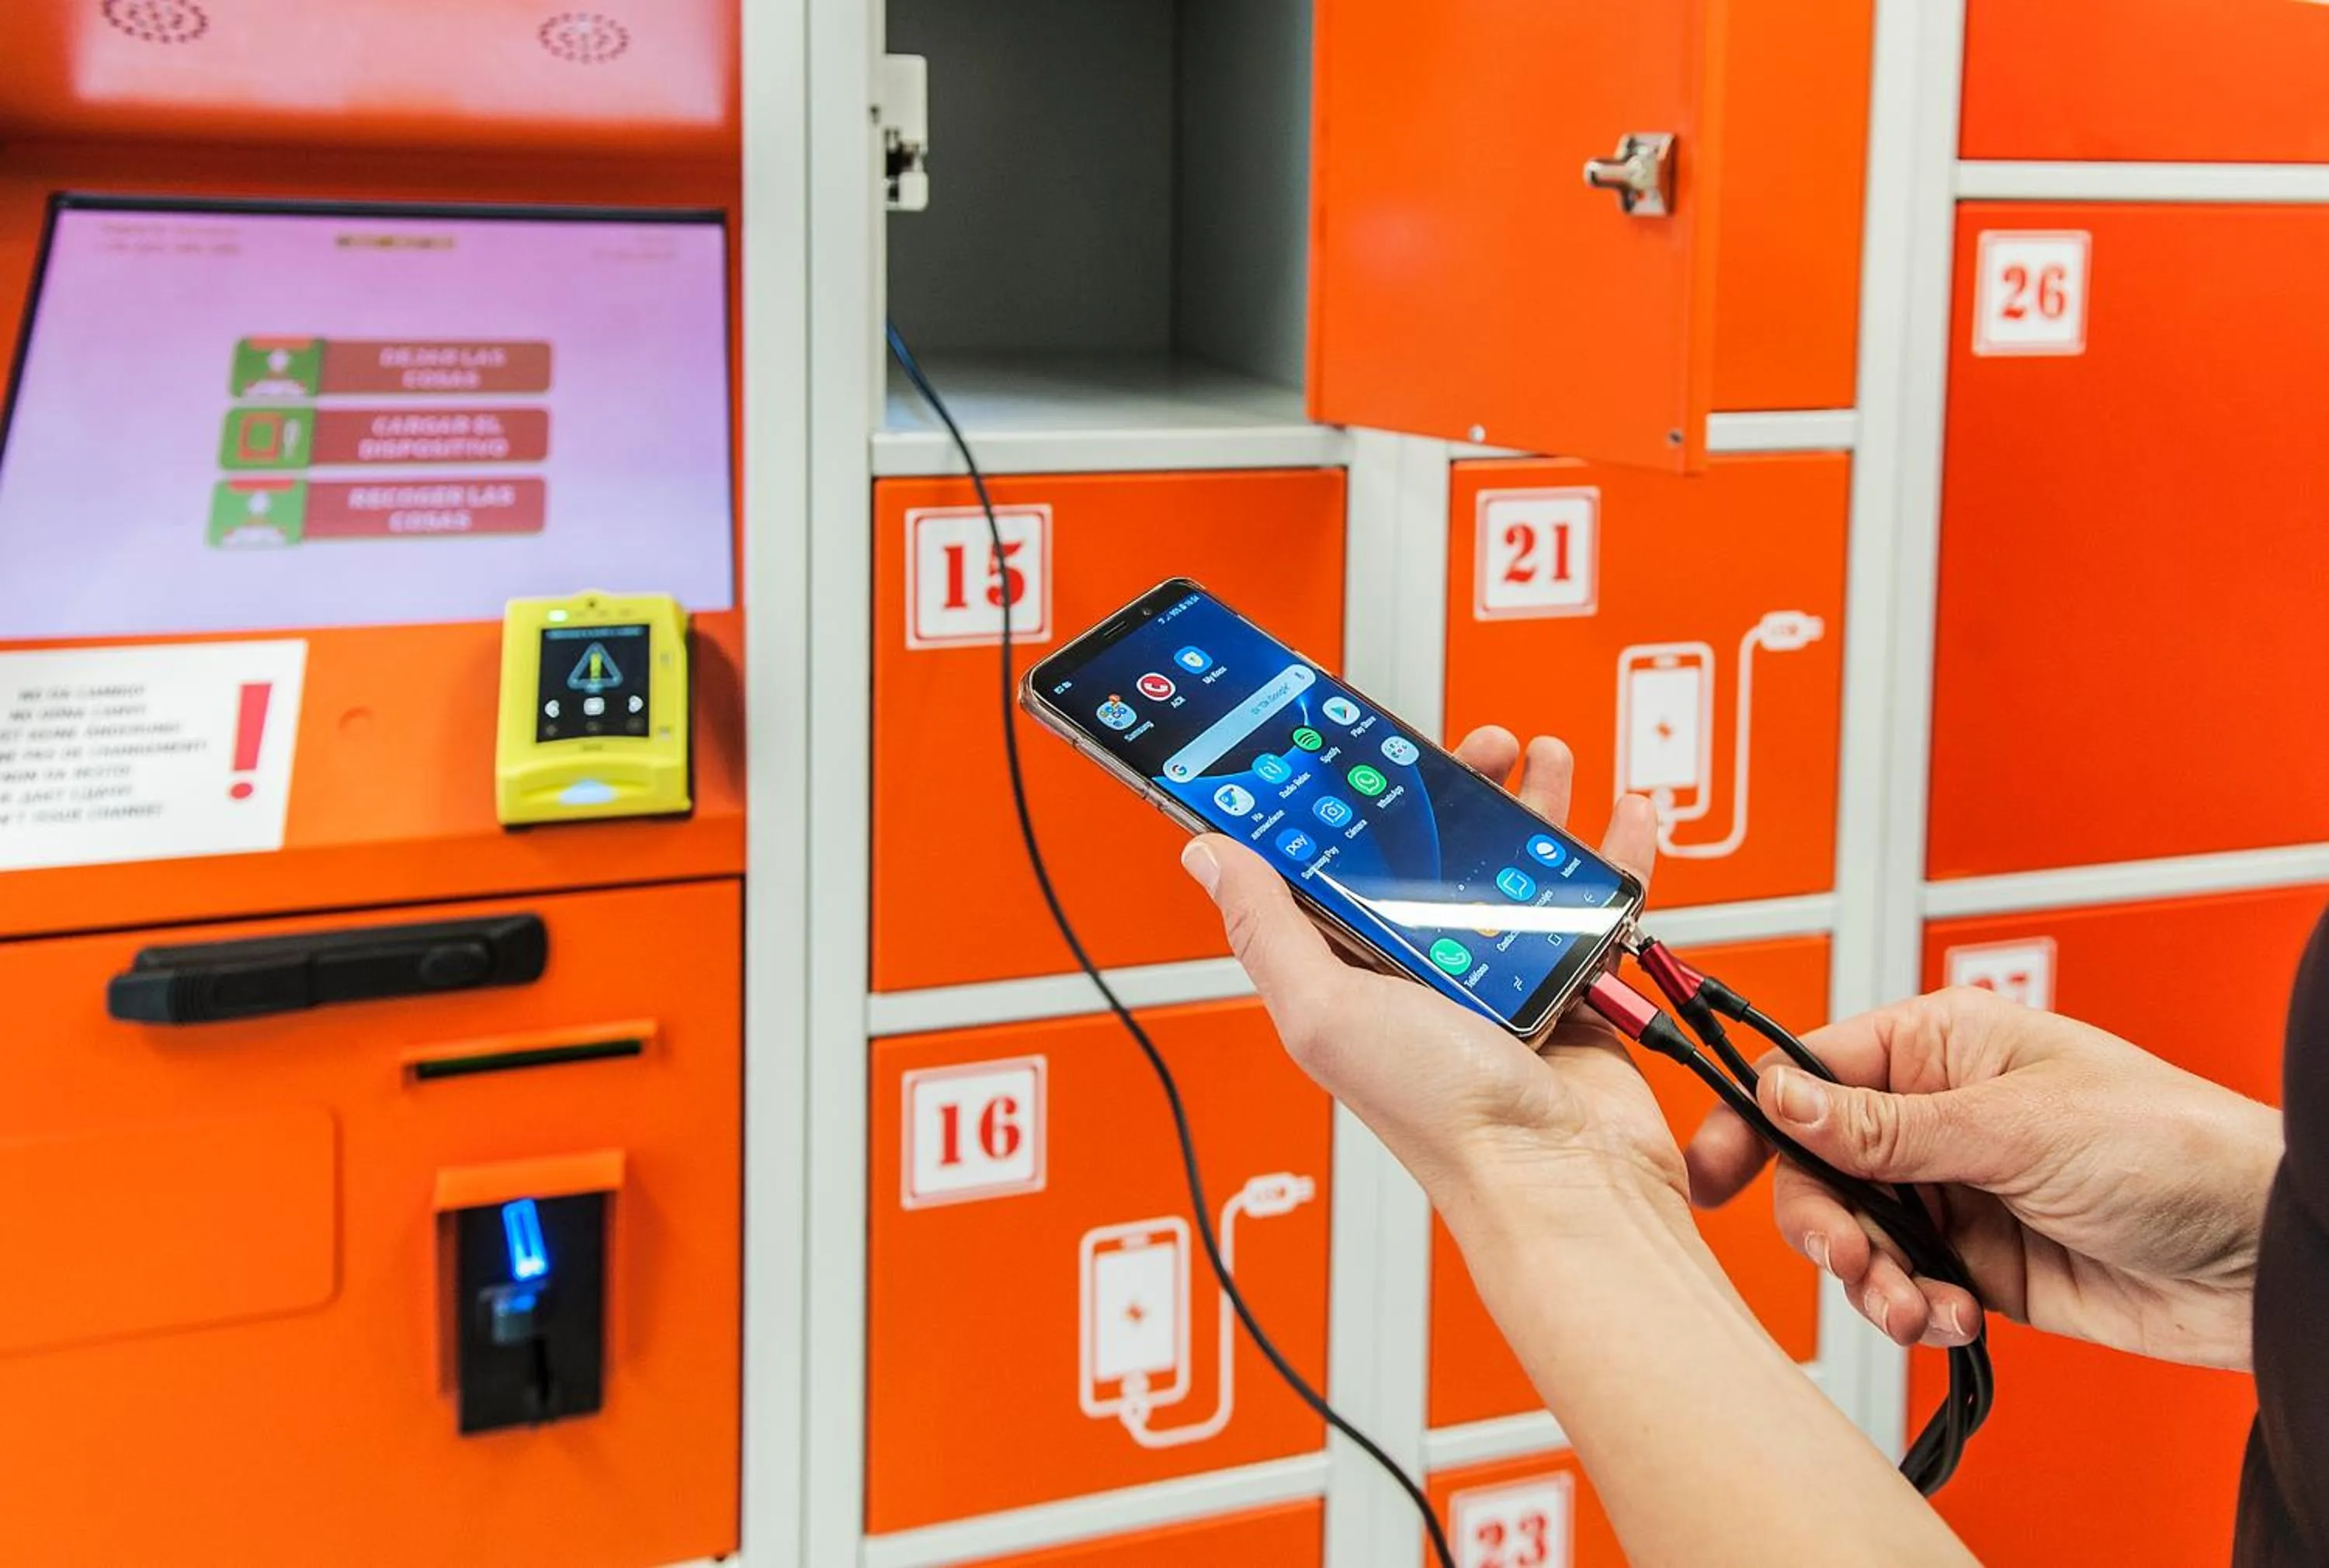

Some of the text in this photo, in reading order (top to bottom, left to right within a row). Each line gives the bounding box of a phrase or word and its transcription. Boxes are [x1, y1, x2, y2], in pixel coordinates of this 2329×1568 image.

[2001, 265, 2066, 320] 26
[1504, 522, 1570, 582] 21
[942, 541, 1025, 609] 15
[1319, 745, 1342, 764] Spotify
[1376, 785, 1405, 810] WhatsApp
[1325, 845, 1340, 860] Pay
[1560, 857, 1581, 878] Internet
[1463, 963, 1490, 989] Teléfono
[939, 1096, 1021, 1166] 16
[1478, 1514, 1547, 1568] 23
